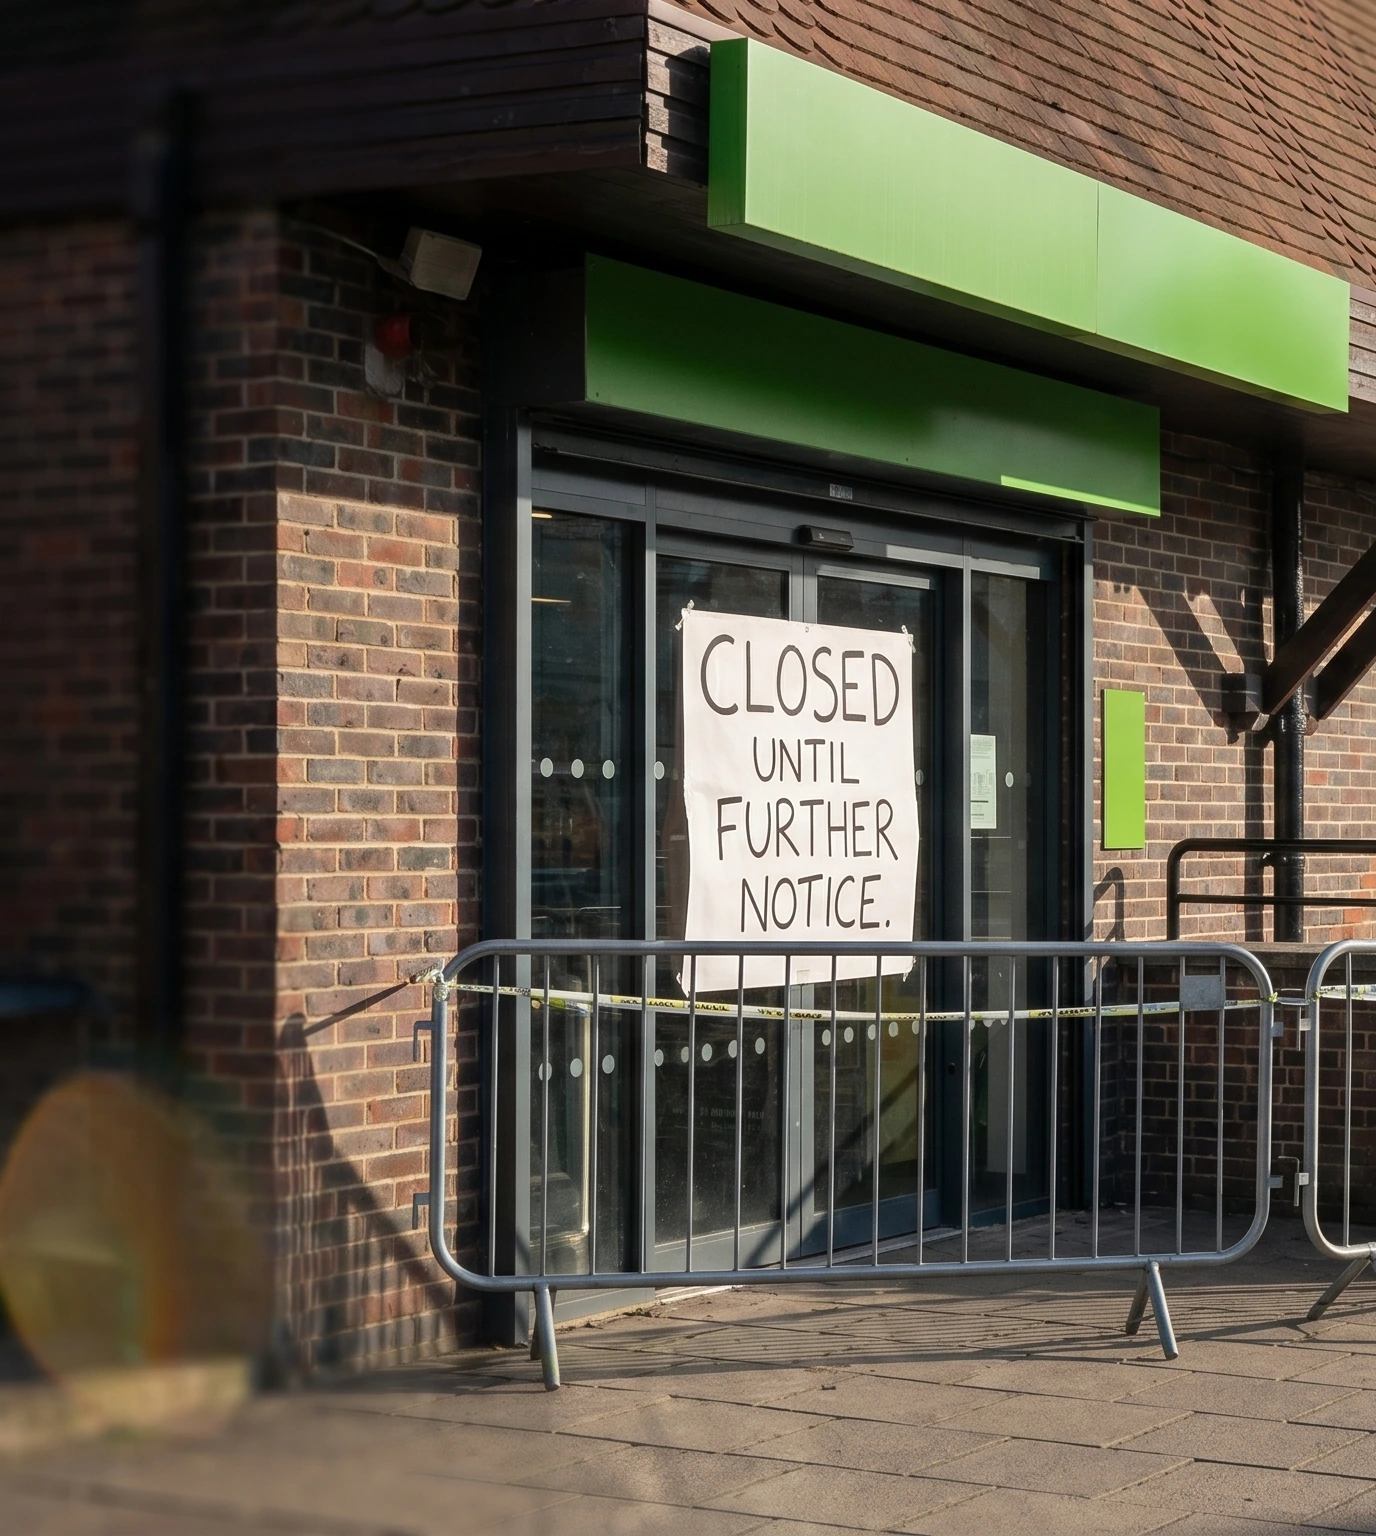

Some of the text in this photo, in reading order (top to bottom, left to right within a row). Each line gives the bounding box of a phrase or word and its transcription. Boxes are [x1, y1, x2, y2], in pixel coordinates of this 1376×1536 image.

[701, 634, 899, 726] CLOSED
[753, 737, 860, 784] UNTIL
[717, 796, 898, 860] FURTHER
[740, 874, 891, 933] NOTICE.
